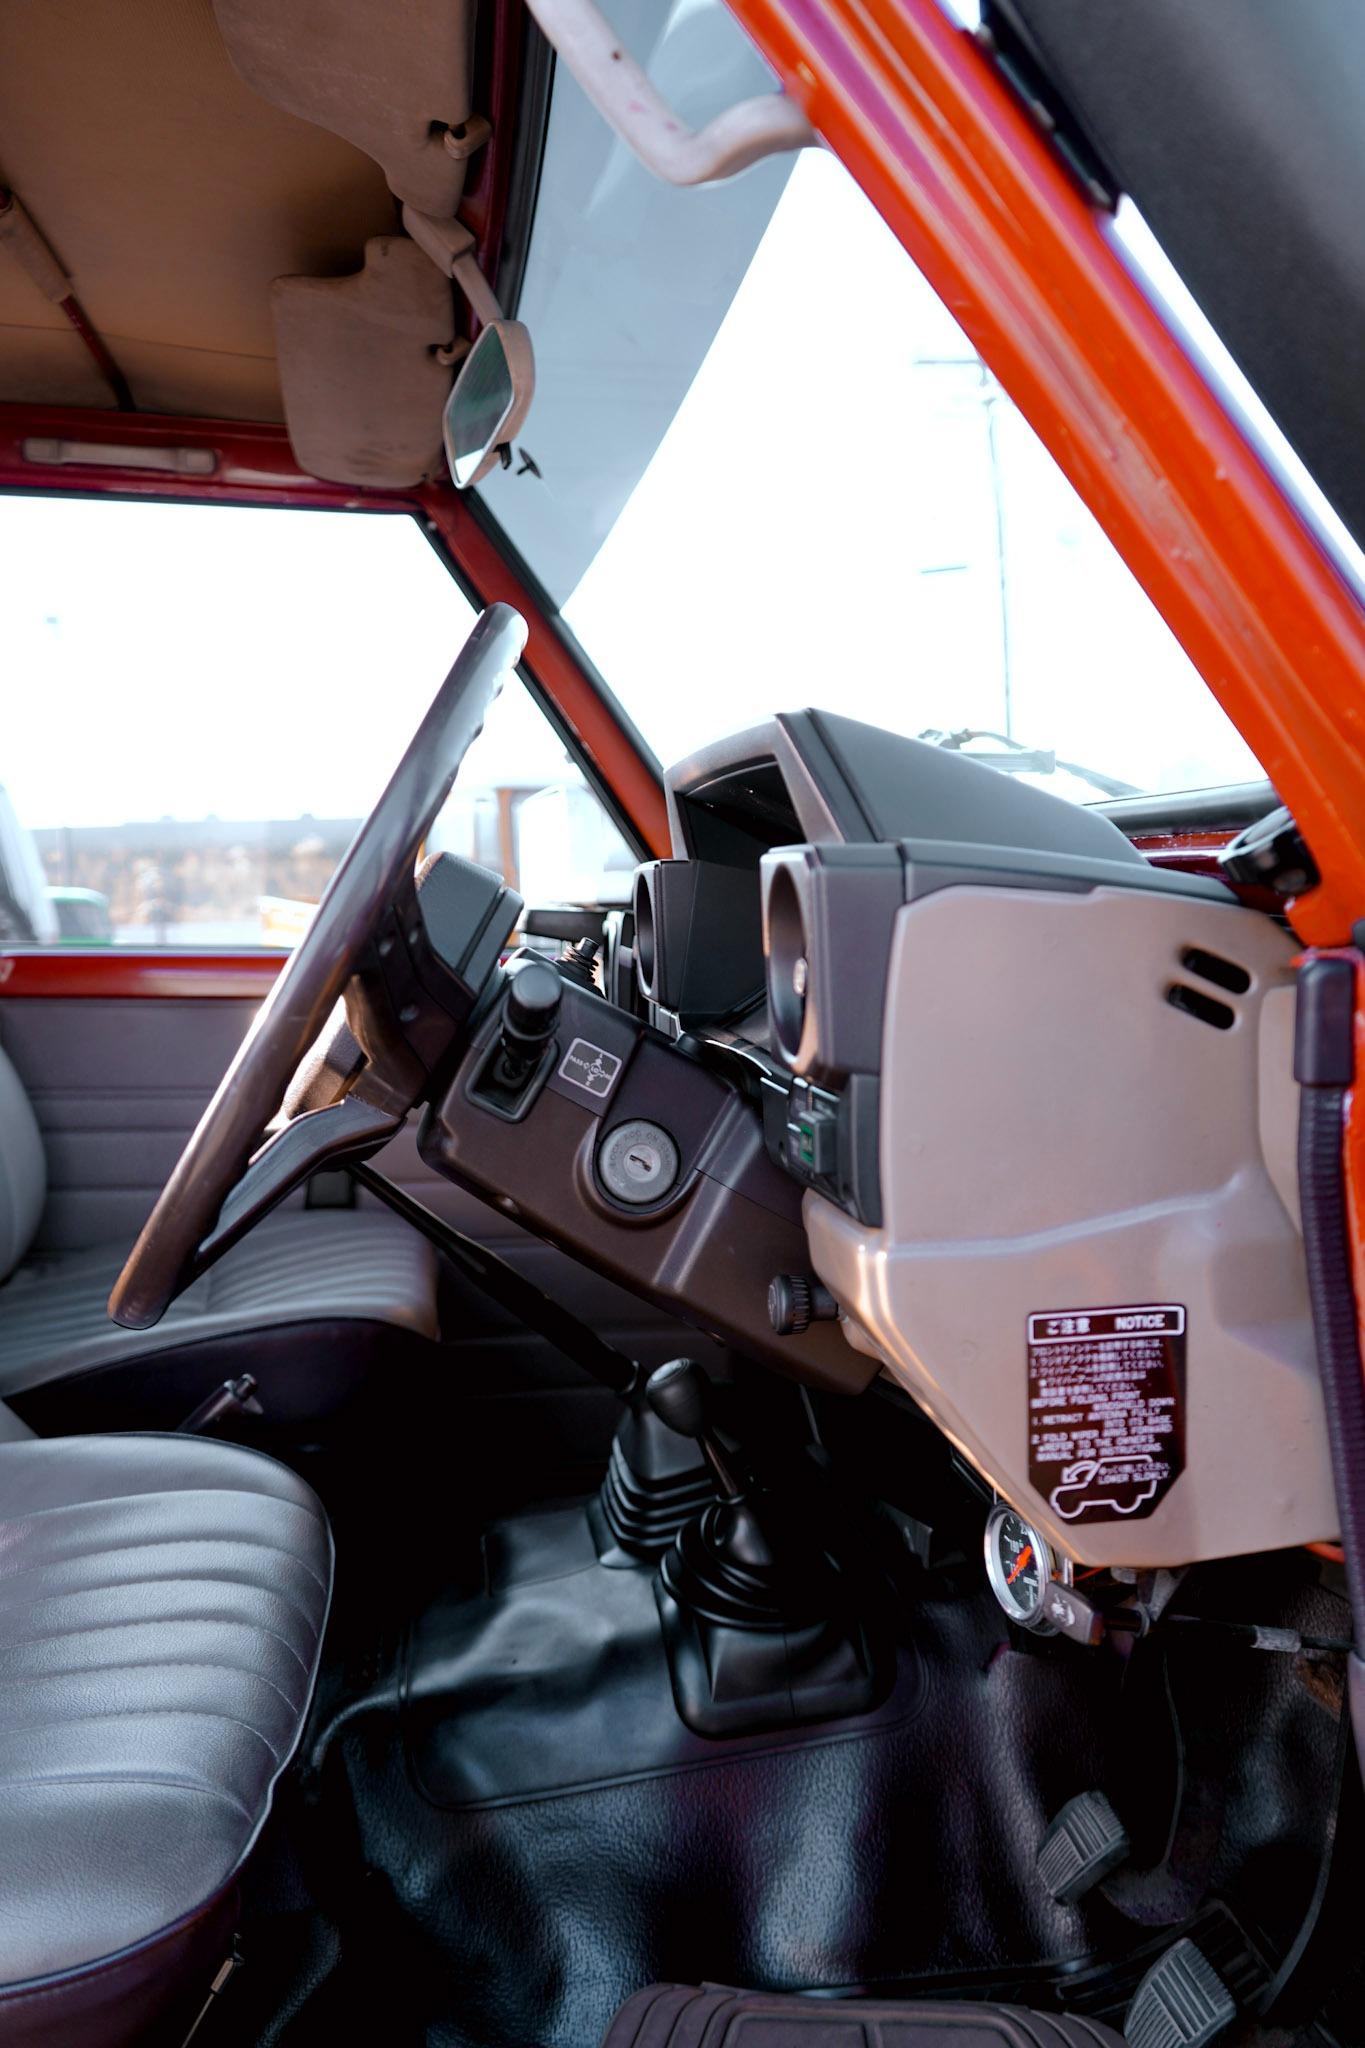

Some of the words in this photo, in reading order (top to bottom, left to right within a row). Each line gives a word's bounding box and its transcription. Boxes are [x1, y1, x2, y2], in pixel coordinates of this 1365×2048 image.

[1115, 1314, 1166, 1330] NOTICE
[1031, 1397, 1067, 1409] BEFORE
[1071, 1394, 1109, 1405] FOLDING
[1111, 1390, 1141, 1401] FRONT
[1093, 1399, 1145, 1411] WINDSHIELD
[1088, 1410, 1128, 1421] ANTENNA
[1132, 1407, 1161, 1418] FULLY
[1104, 1418, 1126, 1429] INTO
[1071, 1429, 1099, 1441] WIPER
[1078, 1439, 1091, 1449] TO
[1094, 1437, 1113, 1447] THE
[1037, 1452, 1074, 1462] MANUAL
[1077, 1448, 1097, 1459] FOR
[1098, 1473, 1129, 1485] LOWER
